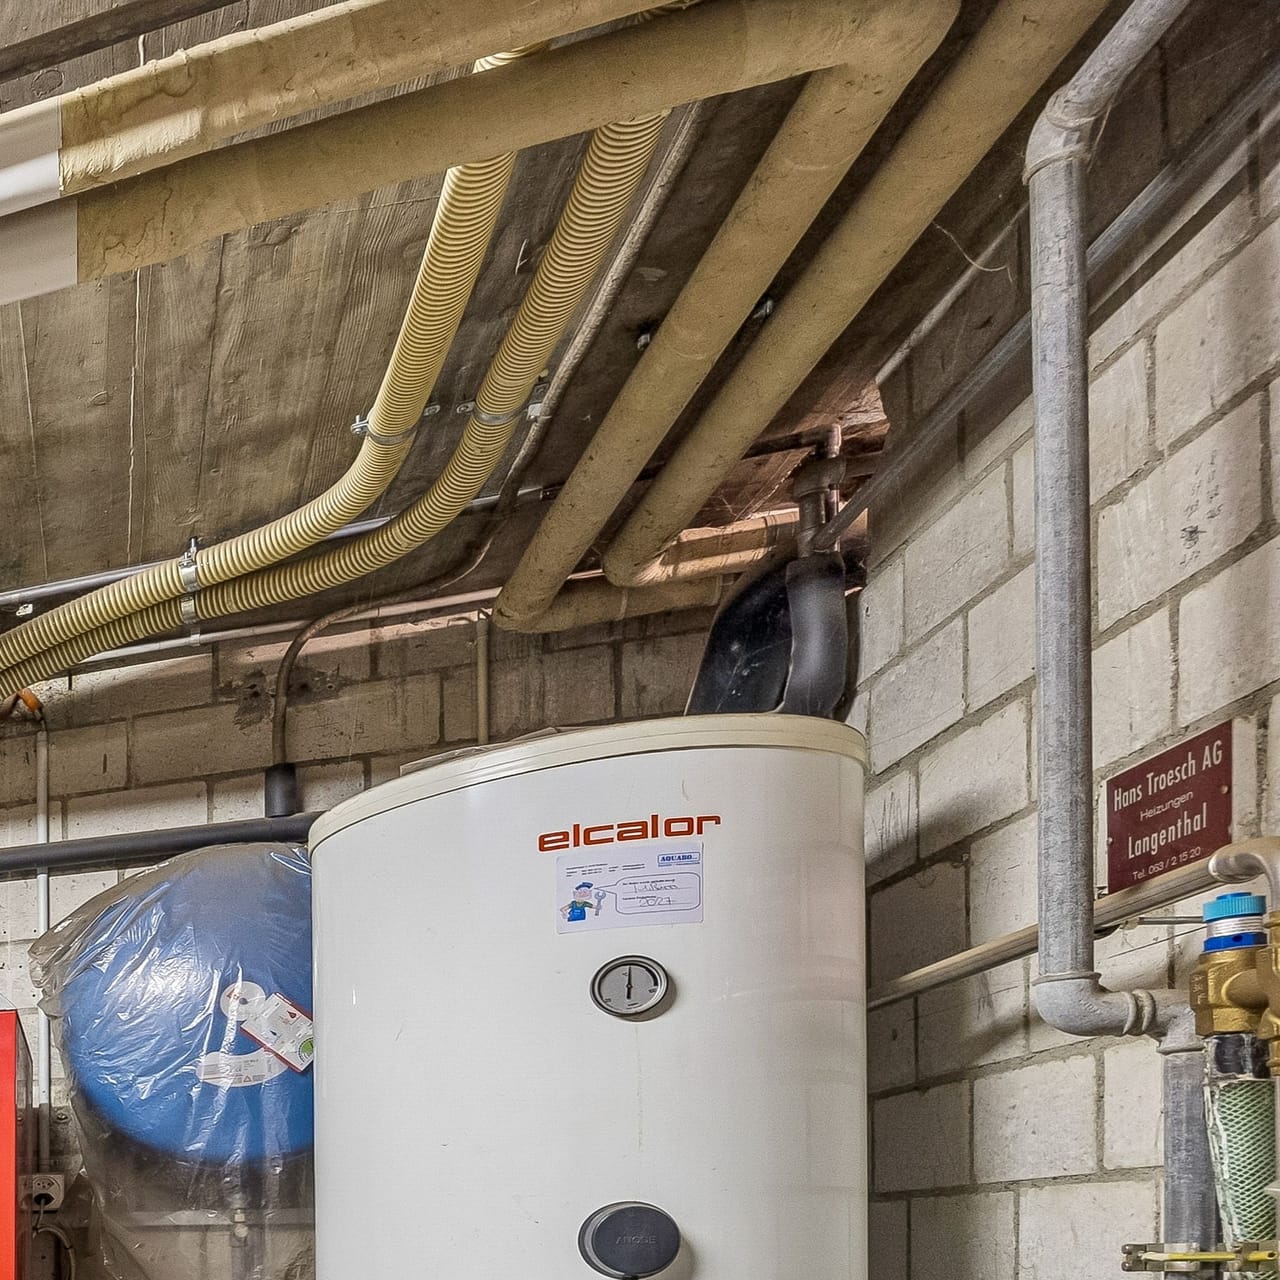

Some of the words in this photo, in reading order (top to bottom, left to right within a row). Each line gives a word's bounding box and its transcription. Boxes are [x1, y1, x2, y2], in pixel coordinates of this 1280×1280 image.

[1114, 784, 1142, 812] Hans
[1146, 751, 1196, 796] Troesch
[1202, 740, 1223, 771] AG
[1140, 791, 1194, 821] Heizungen
[538, 814, 721, 852] elcalor
[1128, 802, 1207, 859] Langenthal
[1171, 856, 1178, 866] 2
[1178, 851, 1188, 863] 15
[1189, 846, 1201, 858] 20
